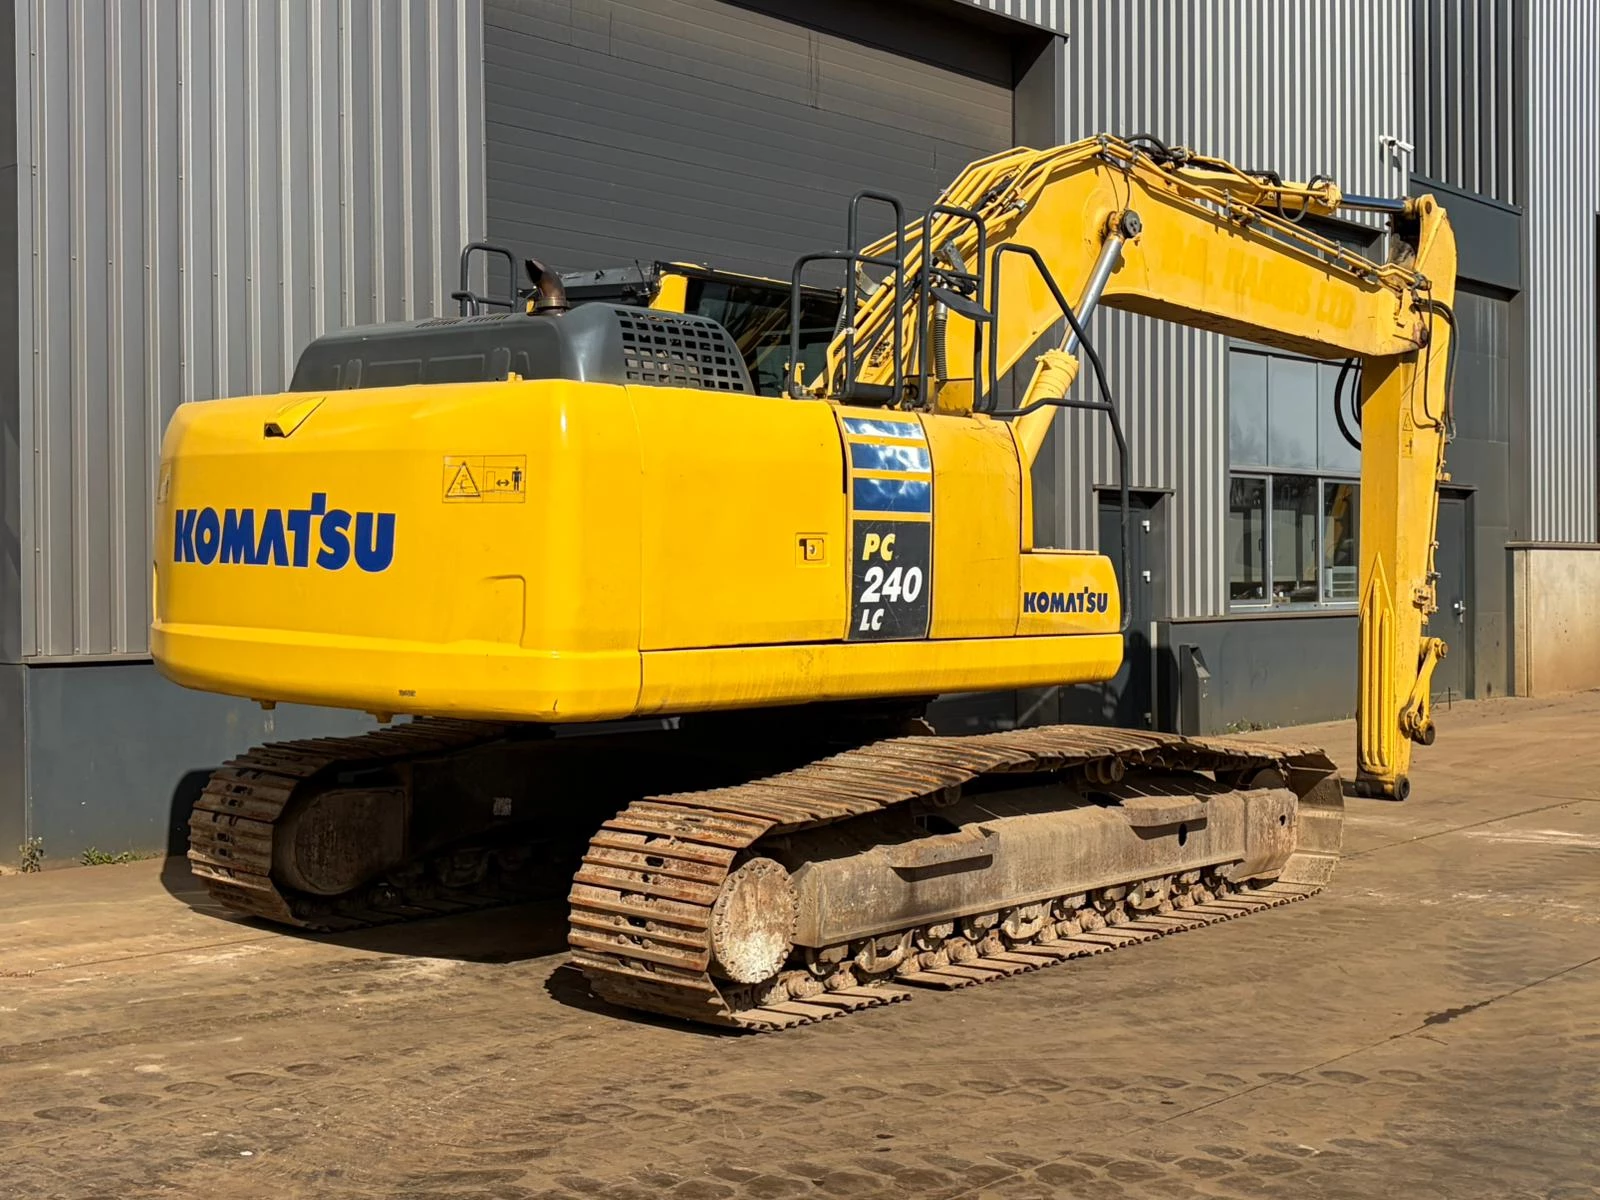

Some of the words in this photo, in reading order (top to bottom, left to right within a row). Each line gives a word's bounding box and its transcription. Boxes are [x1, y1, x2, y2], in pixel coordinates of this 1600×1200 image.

[174, 492, 396, 573] KOMATSU
[862, 533, 896, 562] PC
[859, 566, 923, 603] 240
[1023, 586, 1108, 613] KOMATSU
[859, 608, 885, 631] LC
